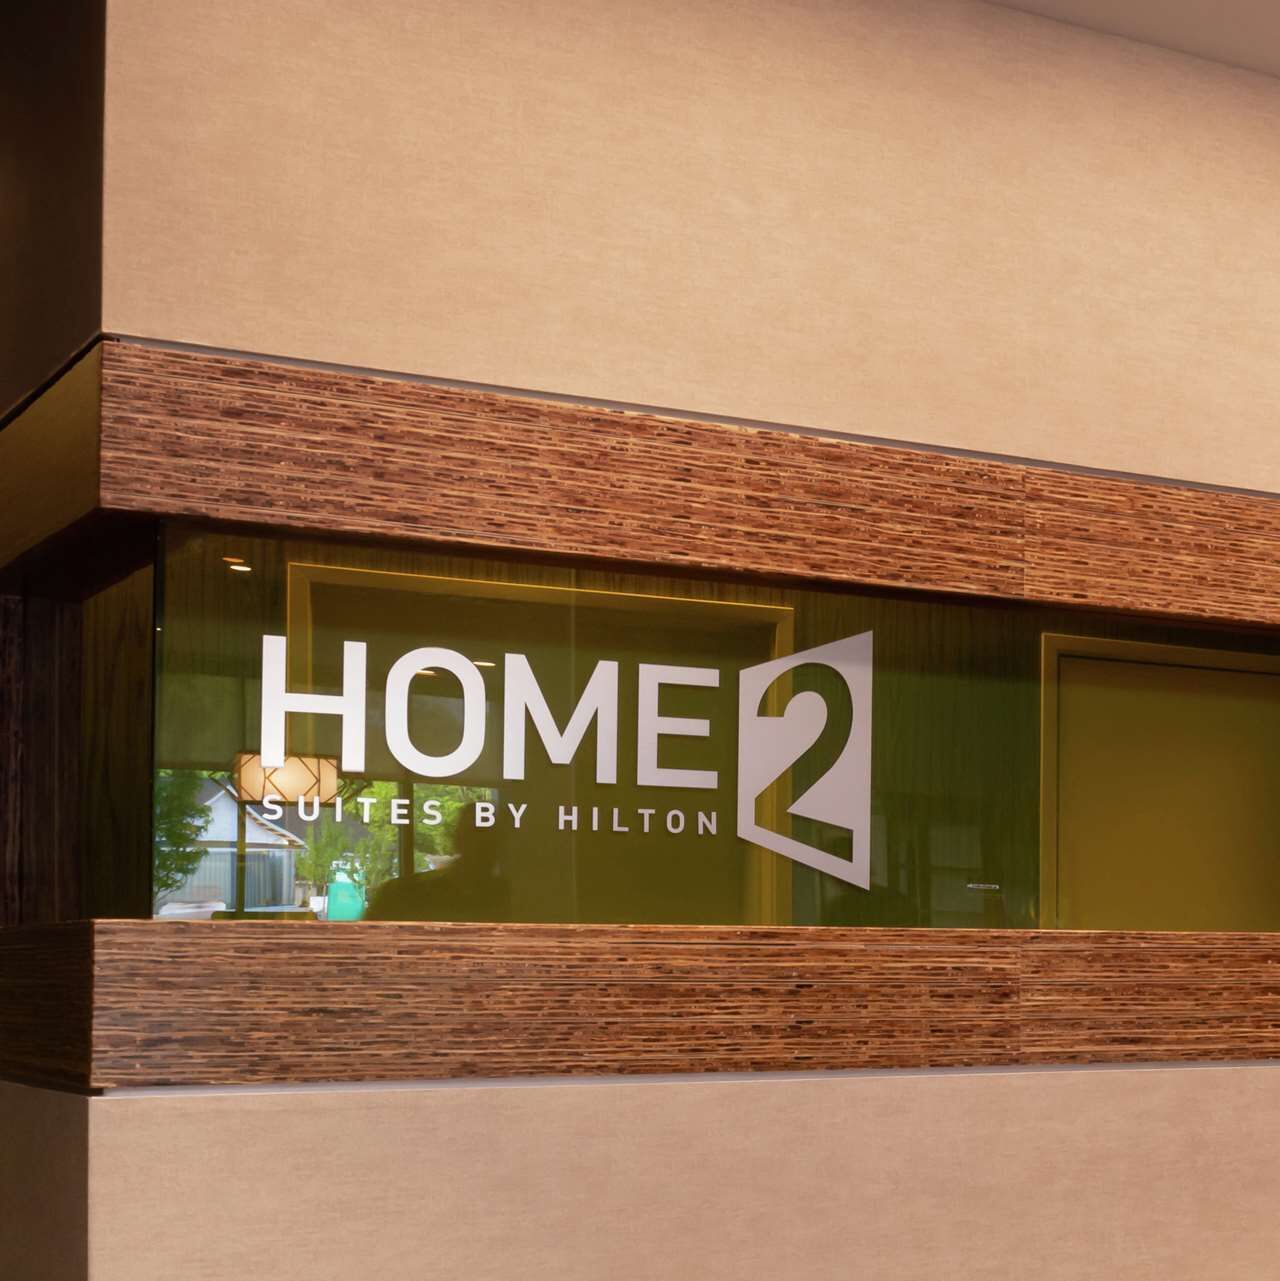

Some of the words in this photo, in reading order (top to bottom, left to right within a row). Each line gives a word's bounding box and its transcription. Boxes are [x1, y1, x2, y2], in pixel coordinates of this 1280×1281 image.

[260, 634, 720, 789] HOME
[755, 661, 856, 866] 2
[261, 795, 443, 827] SUITES
[475, 801, 528, 829] BY
[557, 806, 718, 835] HILTON
